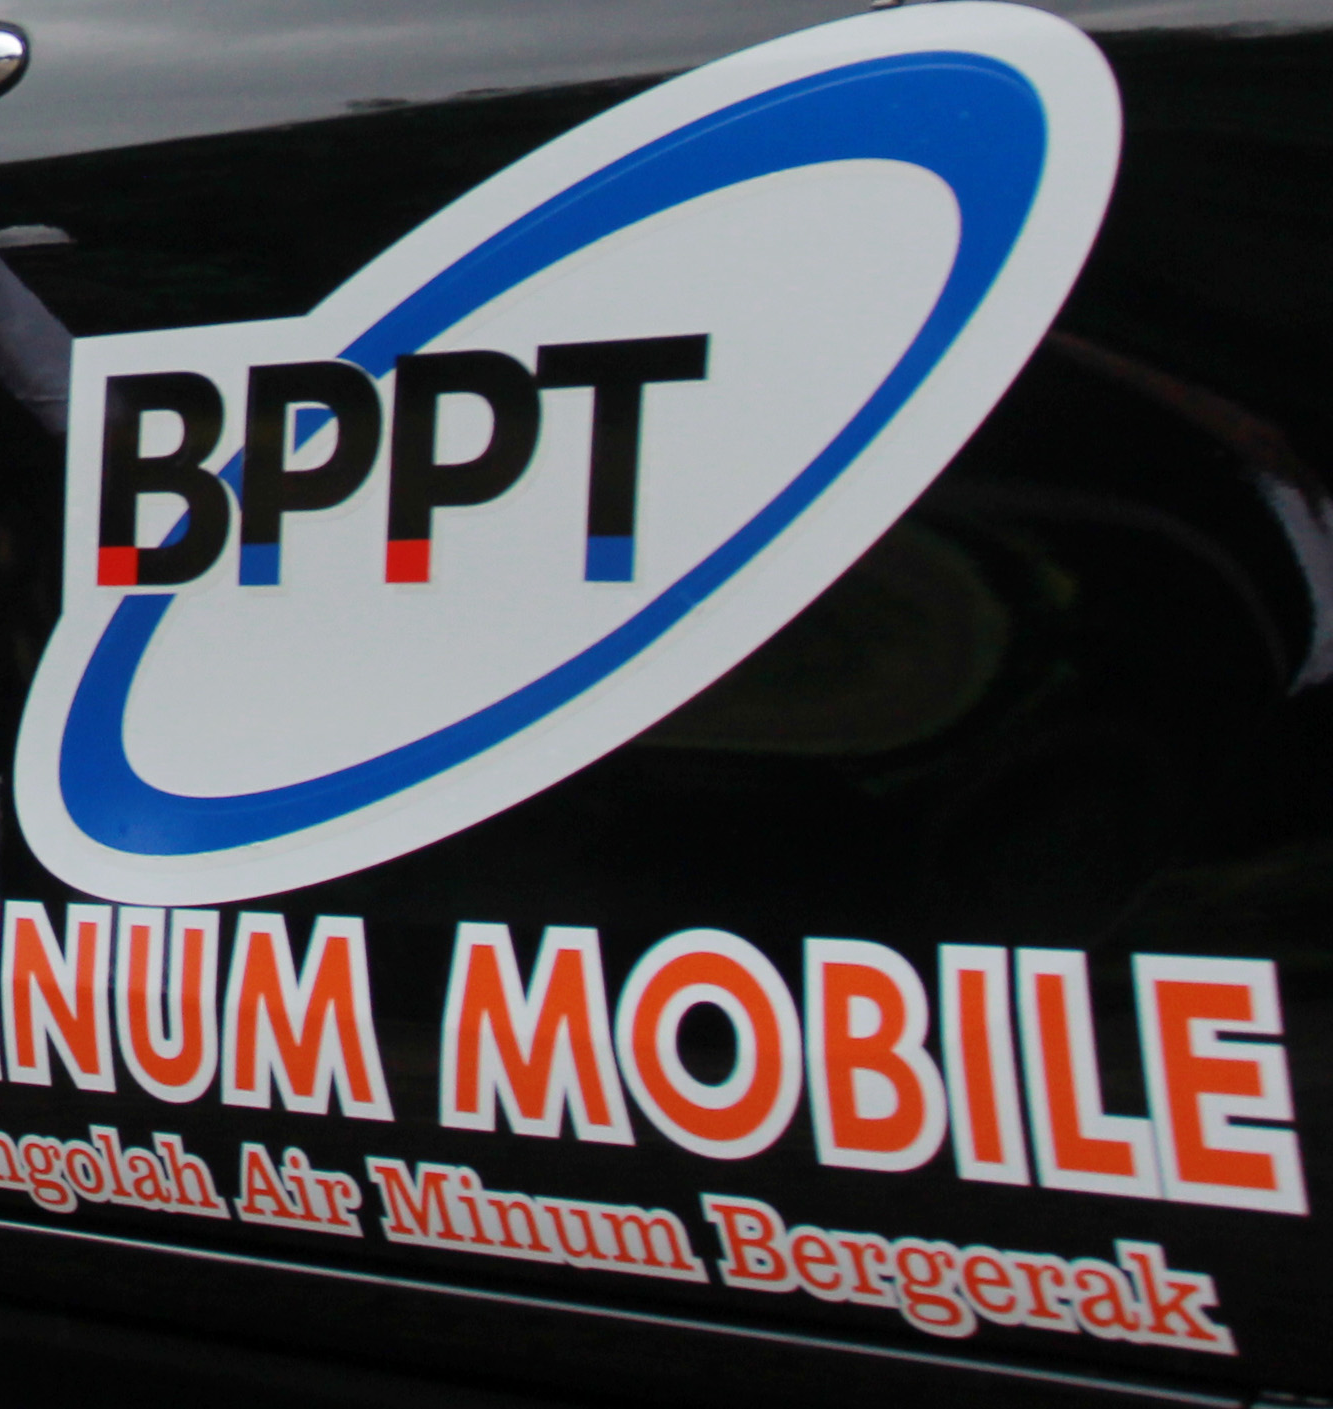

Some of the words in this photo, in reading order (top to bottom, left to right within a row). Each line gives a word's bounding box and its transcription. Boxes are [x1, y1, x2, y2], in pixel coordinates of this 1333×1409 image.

[96, 332, 711, 587] BPPT
[438, 921, 1310, 1216] MOBILE
[235, 1142, 364, 1238] Air
[365, 1155, 709, 1284] Minum
[701, 1193, 1237, 1356] Bergerak
